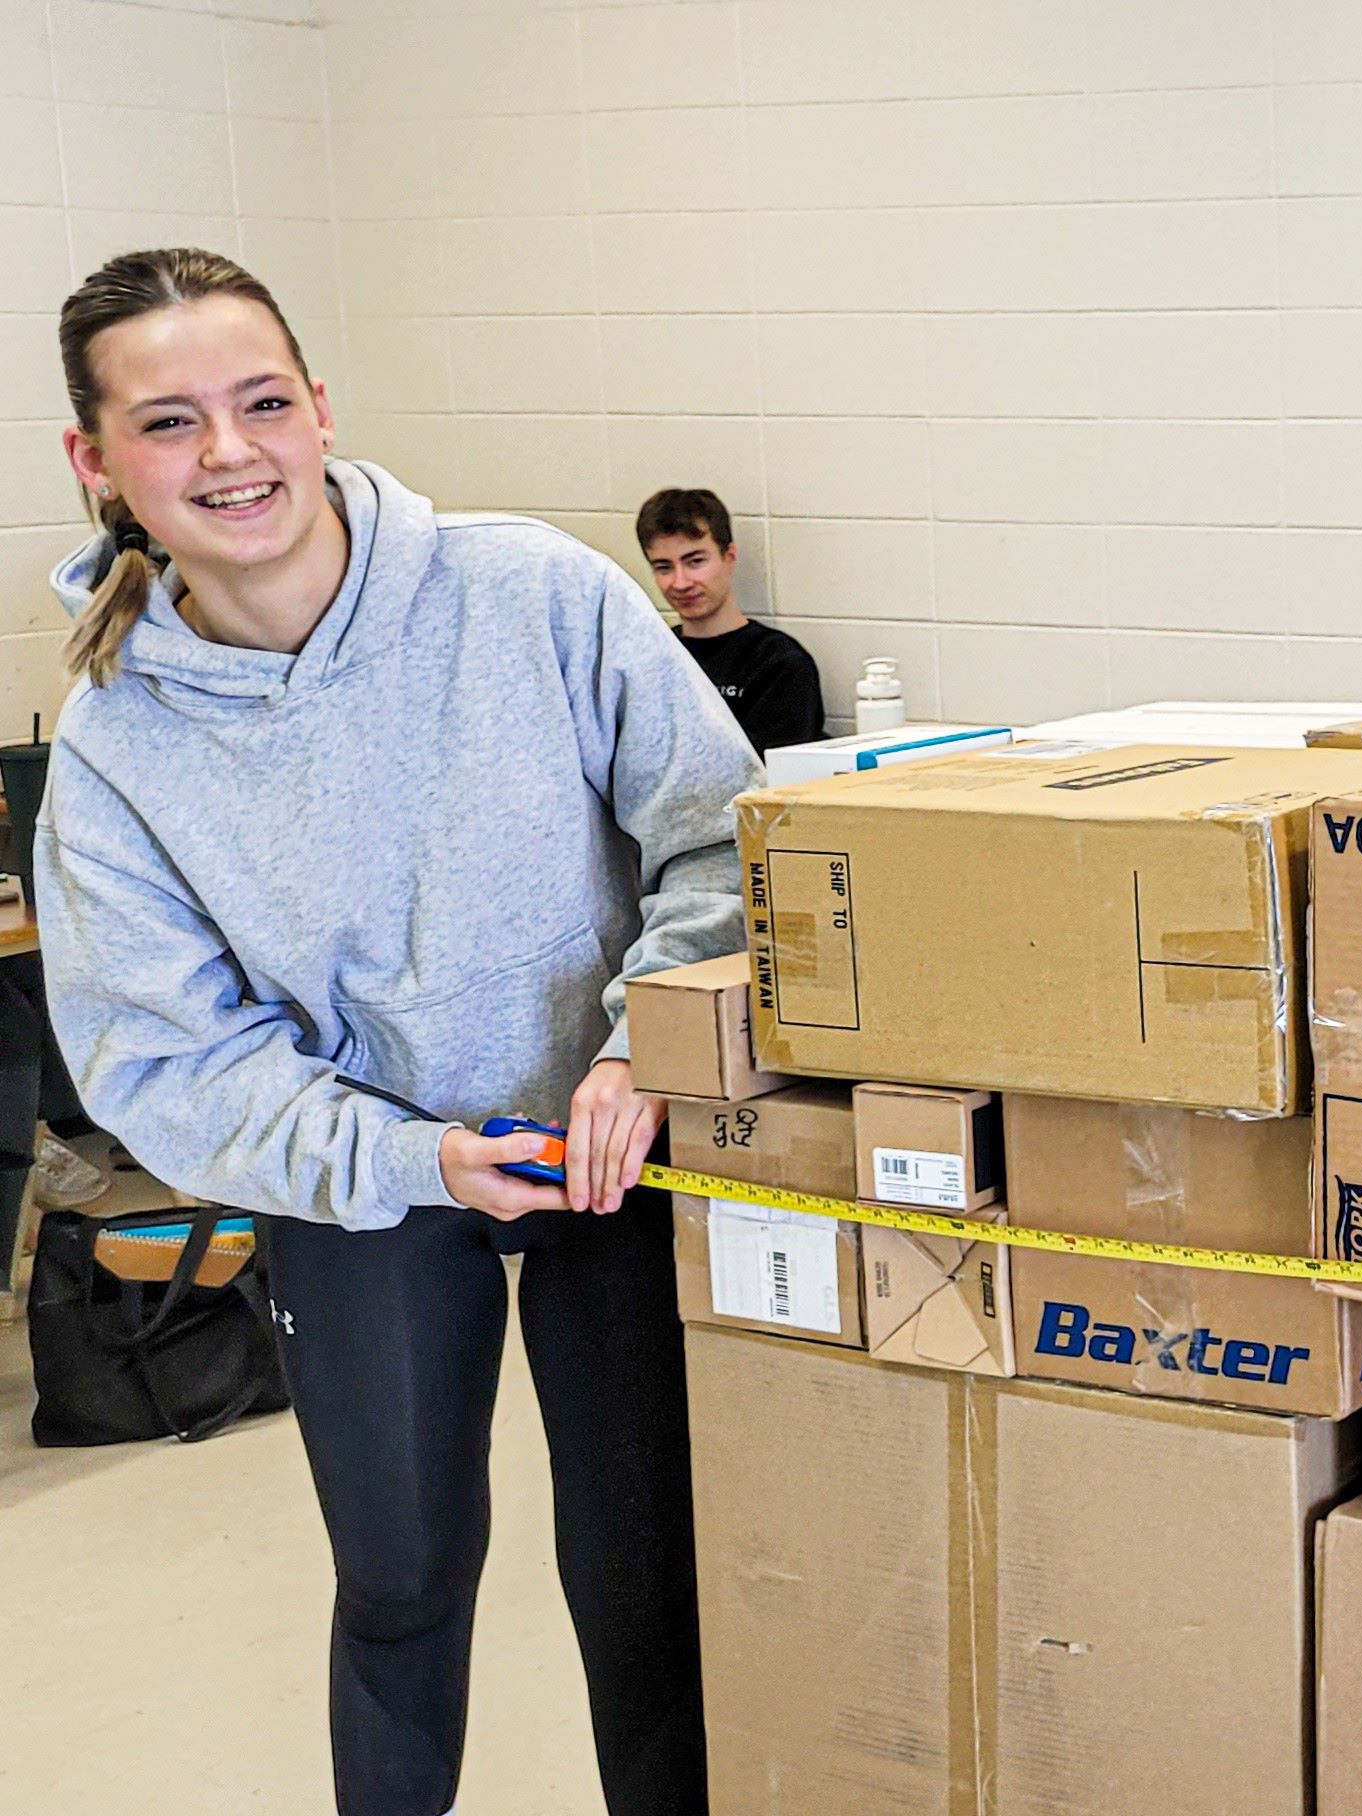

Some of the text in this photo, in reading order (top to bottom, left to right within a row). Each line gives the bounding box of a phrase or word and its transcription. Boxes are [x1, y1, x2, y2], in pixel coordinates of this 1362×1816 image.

[829, 861, 848, 930] SHIP TO
[749, 862, 774, 1010] MADE IN TAIWAN
[731, 1108, 759, 1148] Qty
[1034, 1300, 1311, 1386] Baxter
